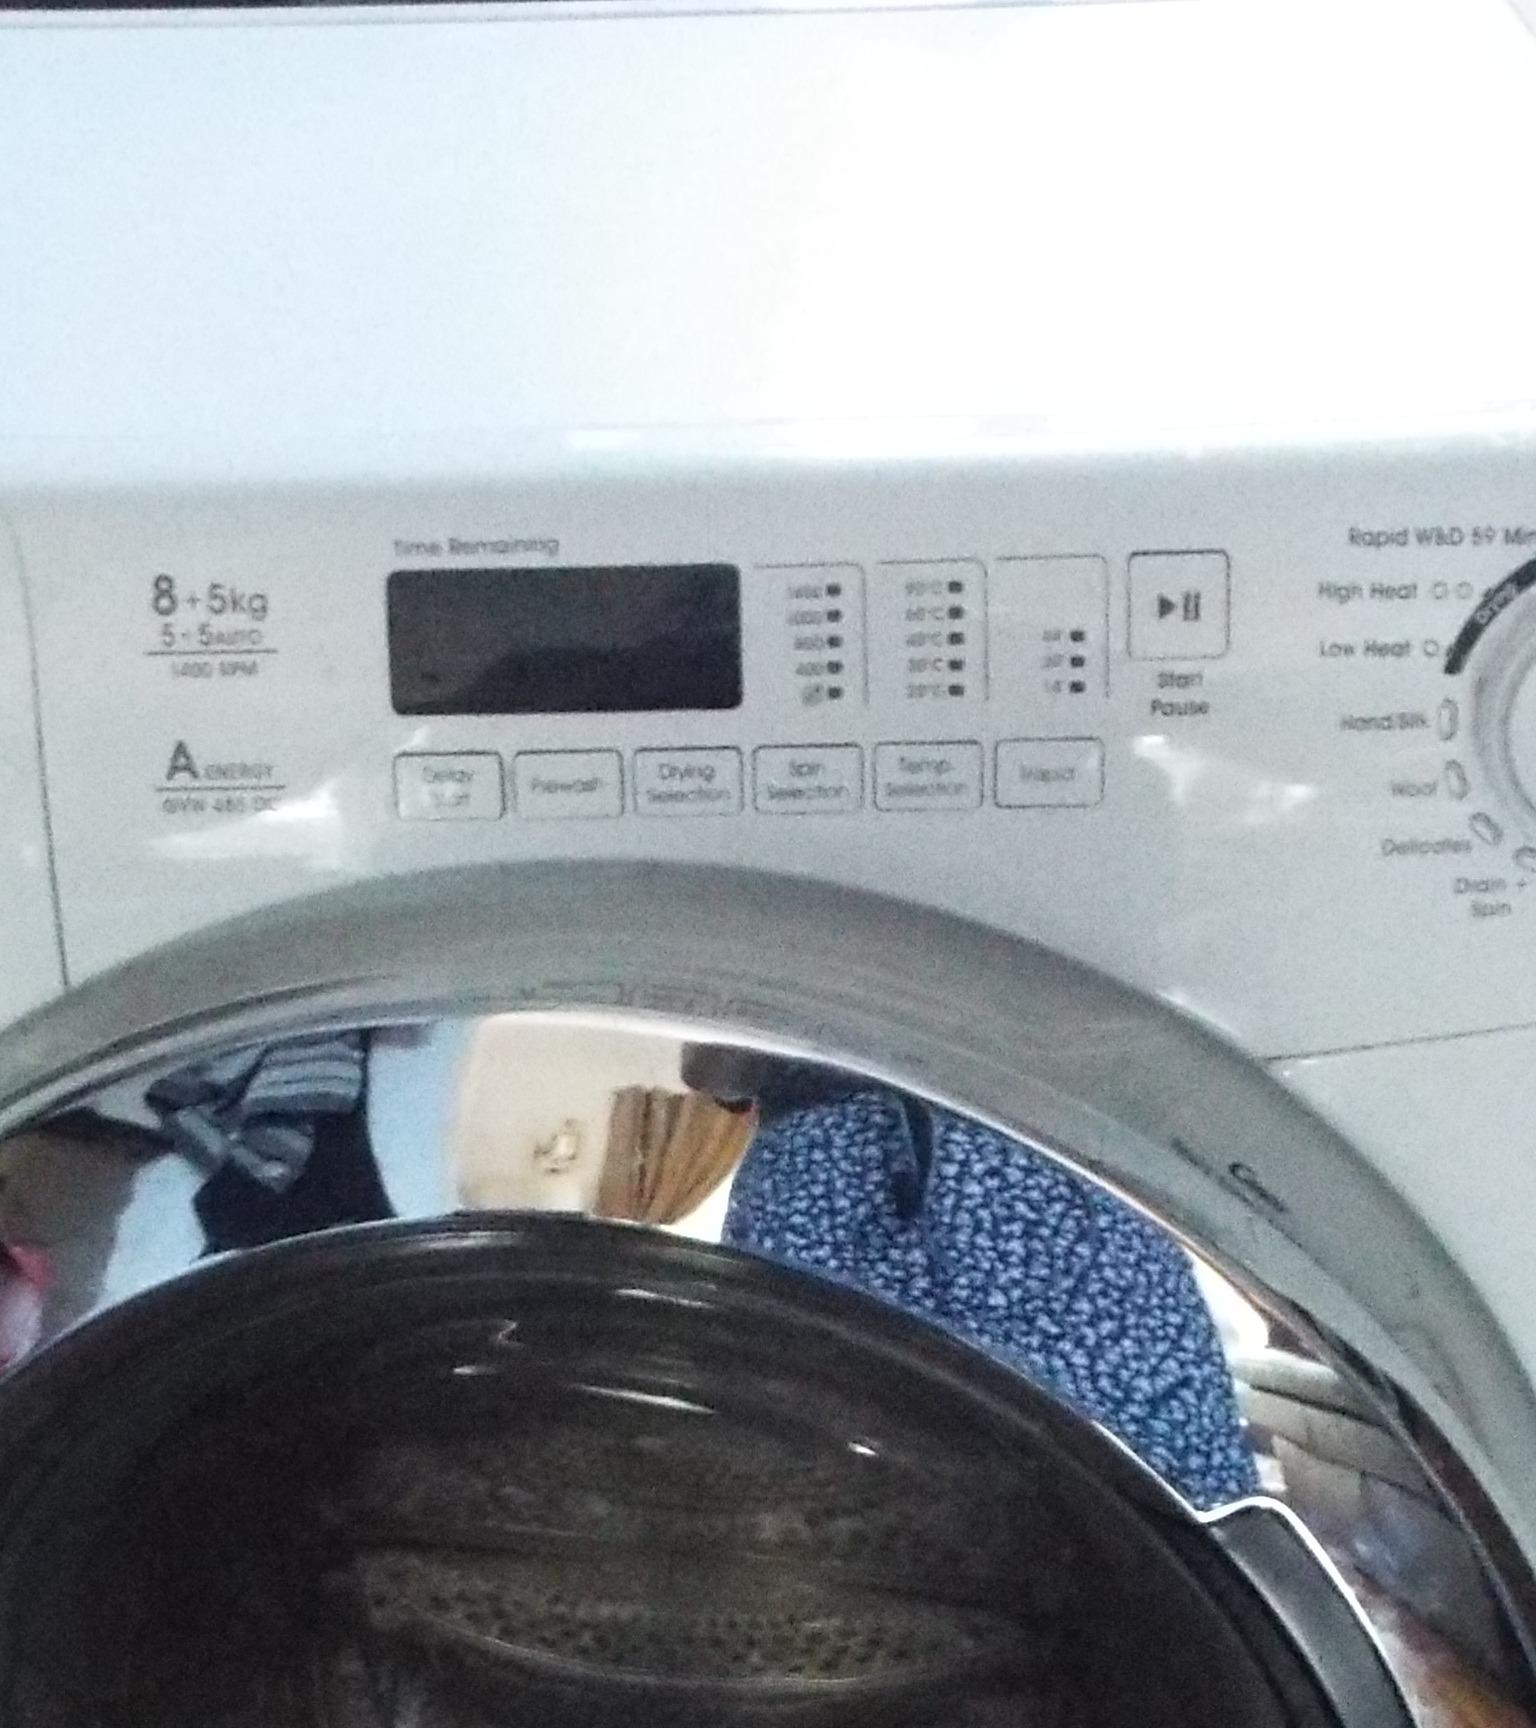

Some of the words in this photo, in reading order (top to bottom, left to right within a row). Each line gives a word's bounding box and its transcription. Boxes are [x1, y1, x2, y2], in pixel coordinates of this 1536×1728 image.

[448, 536, 560, 557] Remaining
[1349, 527, 1410, 549] Rapid
[1415, 527, 1464, 546] W&D
[1318, 581, 1364, 604] High
[1369, 581, 1418, 600] Heat
[1320, 640, 1355, 658] Low
[1365, 640, 1411, 658] Heat
[1158, 671, 1204, 689] Start
[1151, 699, 1211, 717] Pause
[166, 739, 199, 780] A
[657, 761, 716, 783] Drying
[1389, 780, 1438, 798] Wool
[1380, 837, 1472, 857] Delicates
[1453, 877, 1508, 895] Drain
